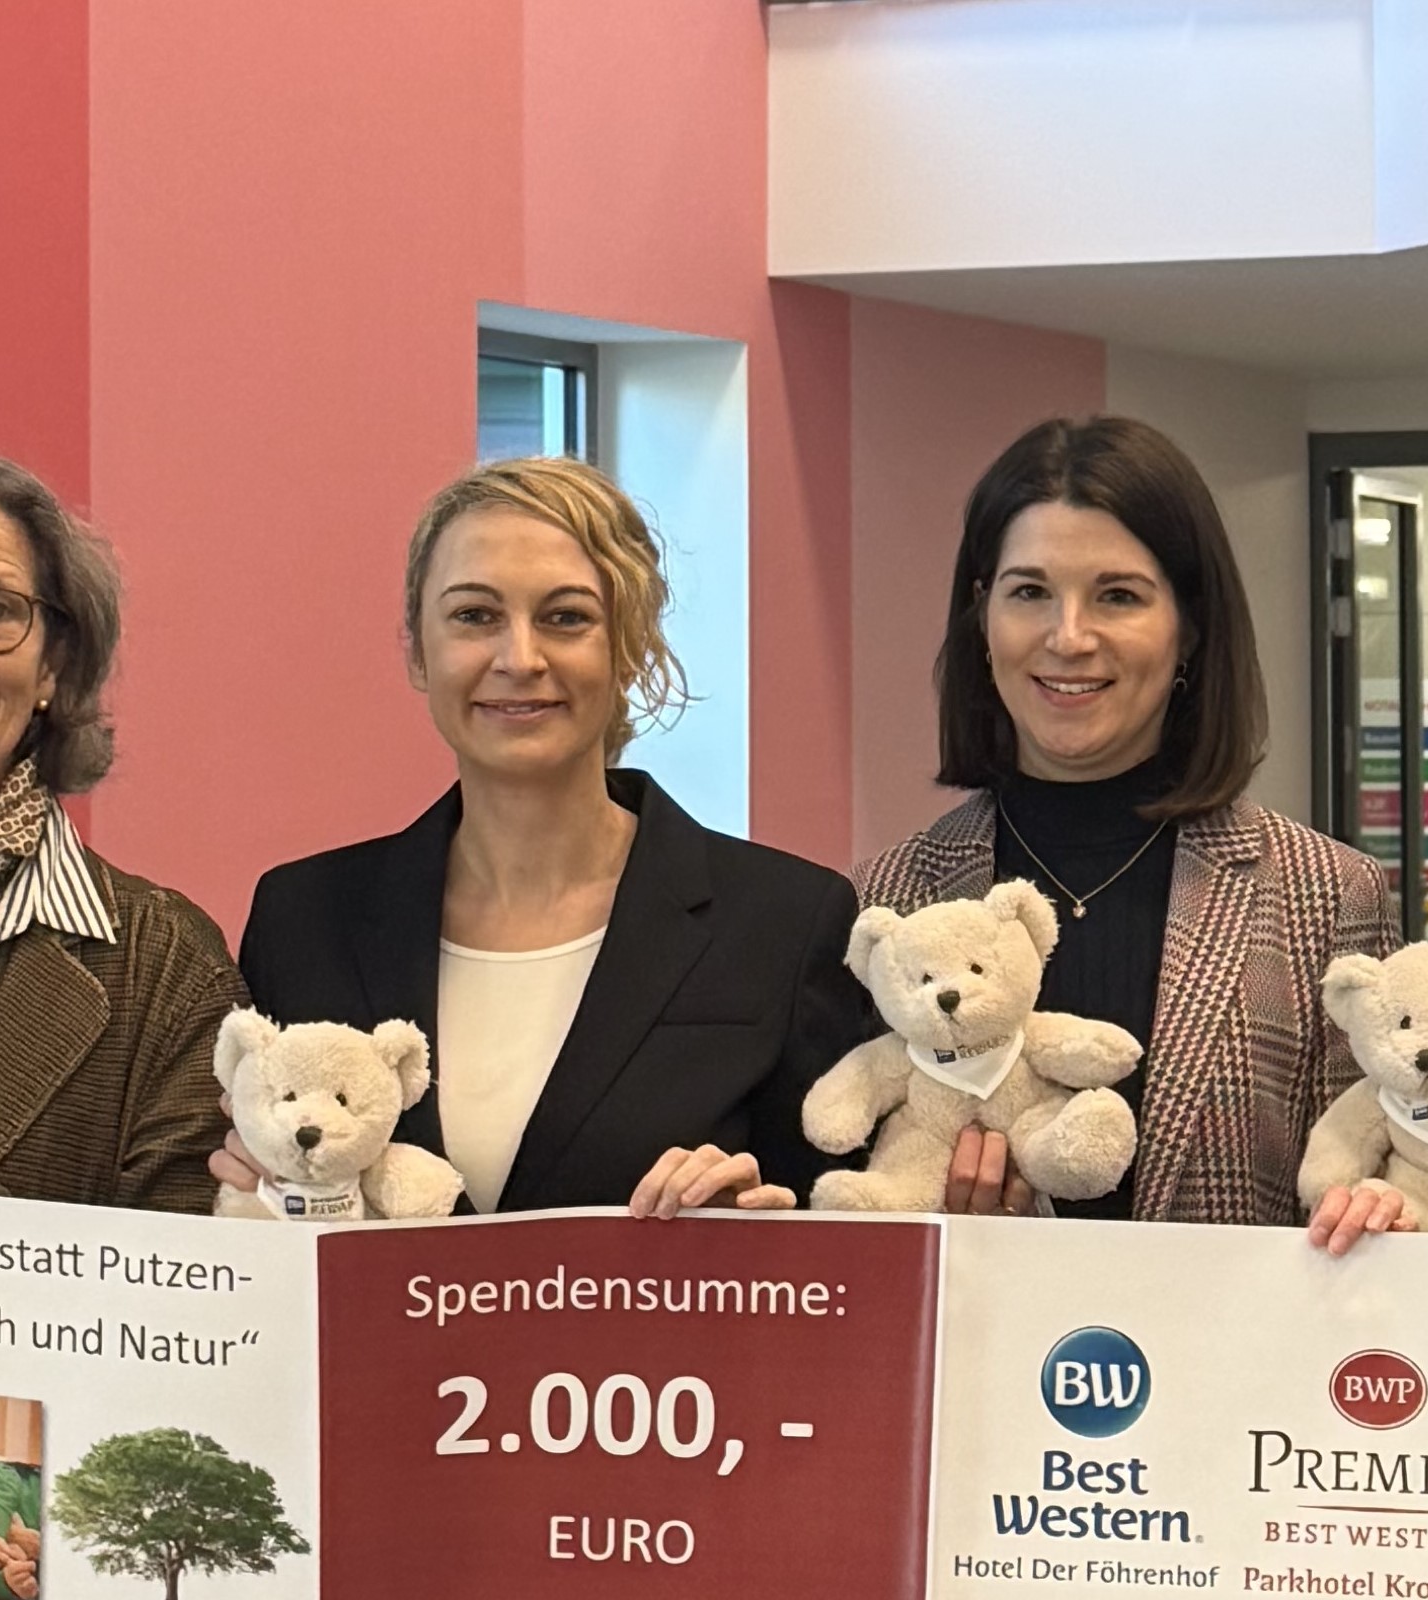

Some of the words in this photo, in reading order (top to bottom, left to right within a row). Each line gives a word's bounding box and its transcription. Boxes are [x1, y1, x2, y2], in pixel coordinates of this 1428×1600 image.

[99, 1245, 252, 1292] Putzen-
[405, 1265, 847, 1326] Spendensumme:
[31, 1319, 103, 1356] und
[1054, 1360, 1141, 1410] BW
[1343, 1375, 1416, 1405] BWP
[1042, 1450, 1149, 1496] Best
[548, 1515, 695, 1565] EURO
[1265, 1521, 1337, 1545] BEST
[954, 1554, 1022, 1579] Hotel
[1032, 1557, 1077, 1582] Der
[1086, 1559, 1220, 1588] Föhrenhof
[1244, 1567, 1375, 1598] Parkhotel
